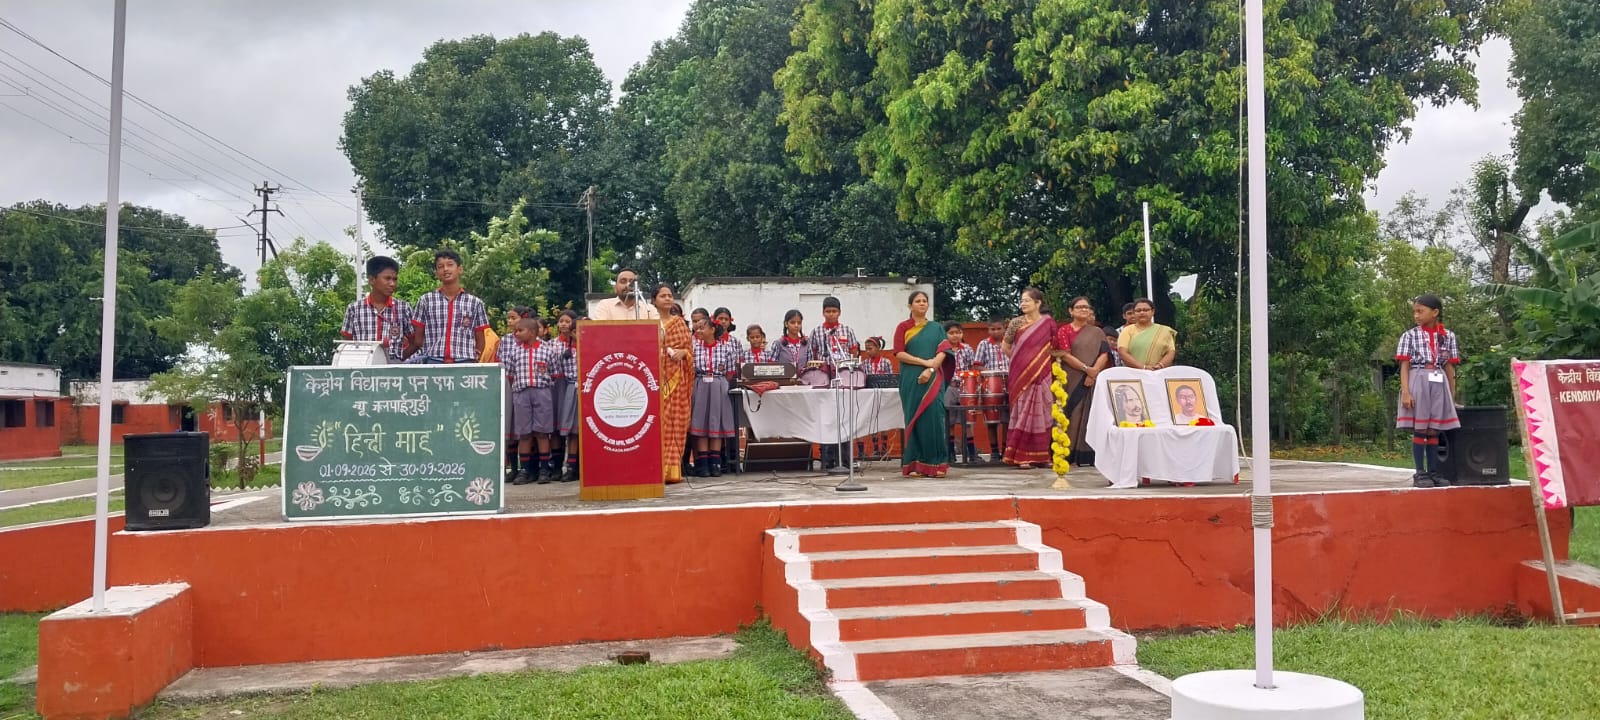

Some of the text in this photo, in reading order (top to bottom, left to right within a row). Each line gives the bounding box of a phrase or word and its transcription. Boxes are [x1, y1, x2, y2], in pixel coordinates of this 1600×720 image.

[351, 371, 403, 392] विद्यालय
[460, 374, 489, 390] आर
[378, 457, 396, 476] से
